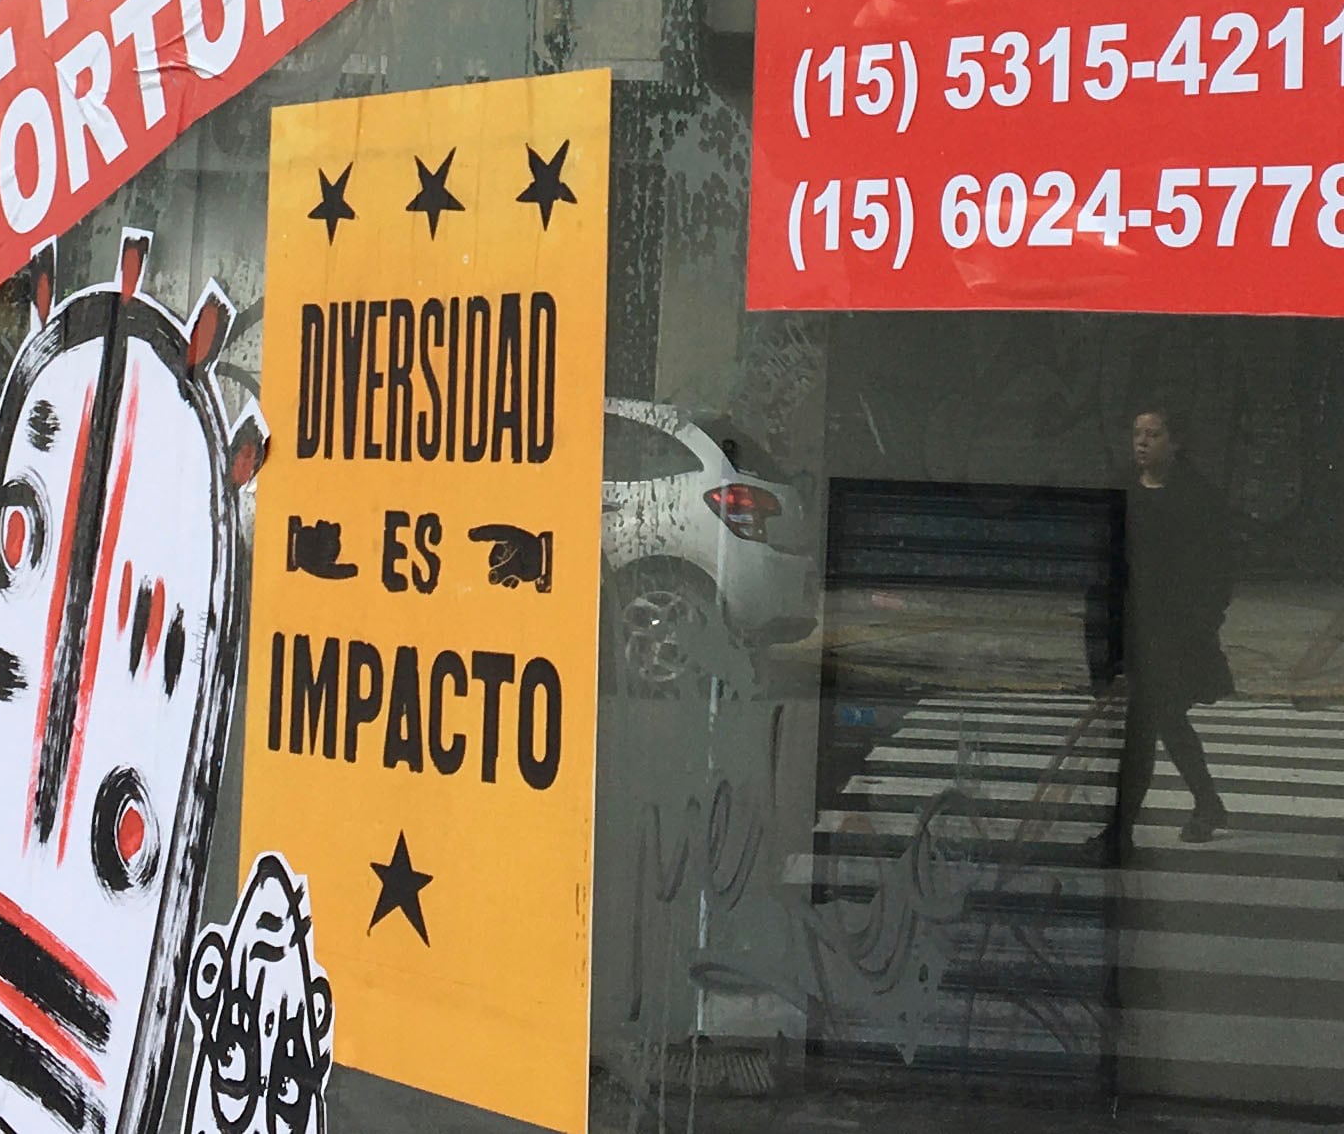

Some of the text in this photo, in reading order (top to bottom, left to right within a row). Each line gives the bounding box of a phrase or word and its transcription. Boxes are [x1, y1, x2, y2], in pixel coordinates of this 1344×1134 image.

[792, 40, 919, 138] (15)
[788, 177, 914, 270] (15)
[297, 292, 556, 464] DIVERSIDAD
[381, 510, 442, 595] ES
[268, 631, 562, 791] IMPACTO
